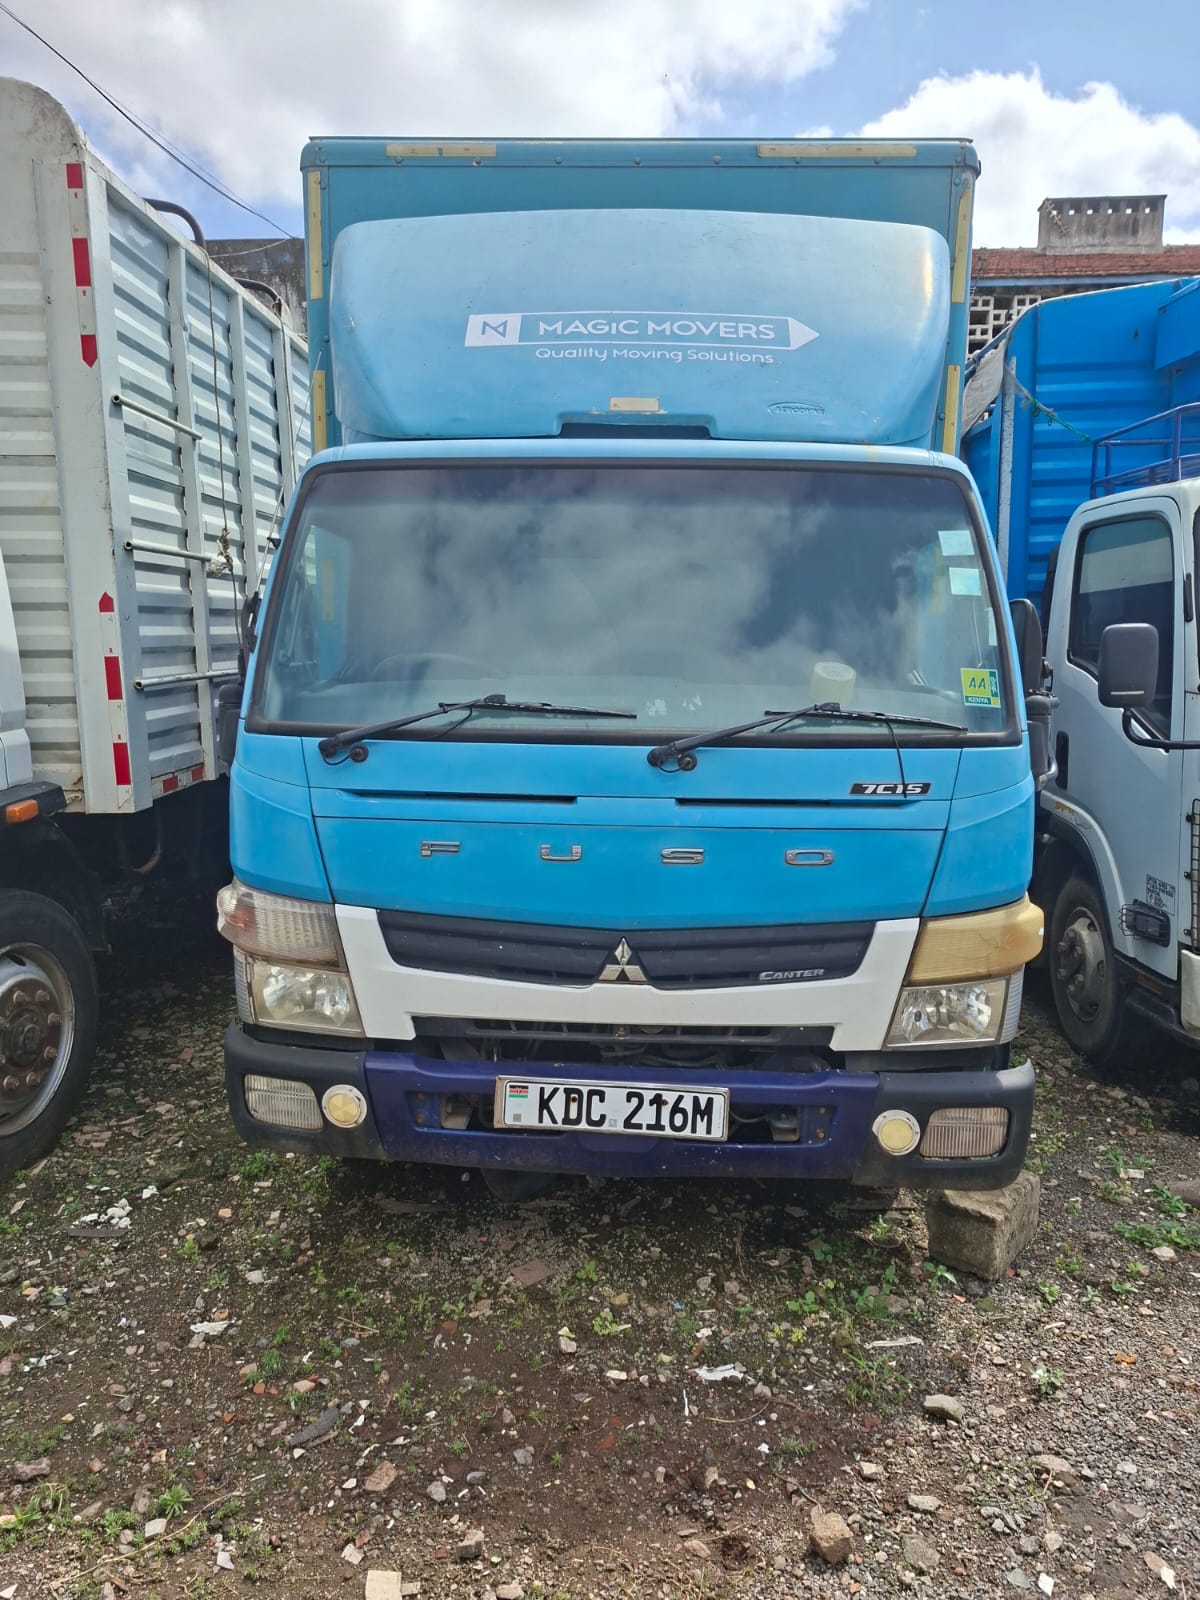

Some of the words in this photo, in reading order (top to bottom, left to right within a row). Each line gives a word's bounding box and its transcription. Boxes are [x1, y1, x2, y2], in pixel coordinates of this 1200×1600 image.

[539, 319, 640, 336] MAGIC
[647, 320, 776, 339] MOVERS
[535, 347, 608, 362] Quality
[612, 349, 682, 363] Moving
[687, 349, 774, 364] Solutions
[968, 676, 986, 690] AA
[967, 696, 989, 704] KENYA
[861, 783, 923, 794] 7C15
[419, 840, 835, 867] FUSO
[759, 968, 825, 981] CANTER
[538, 1086, 606, 1128] KDC
[623, 1091, 714, 1136] 216M
